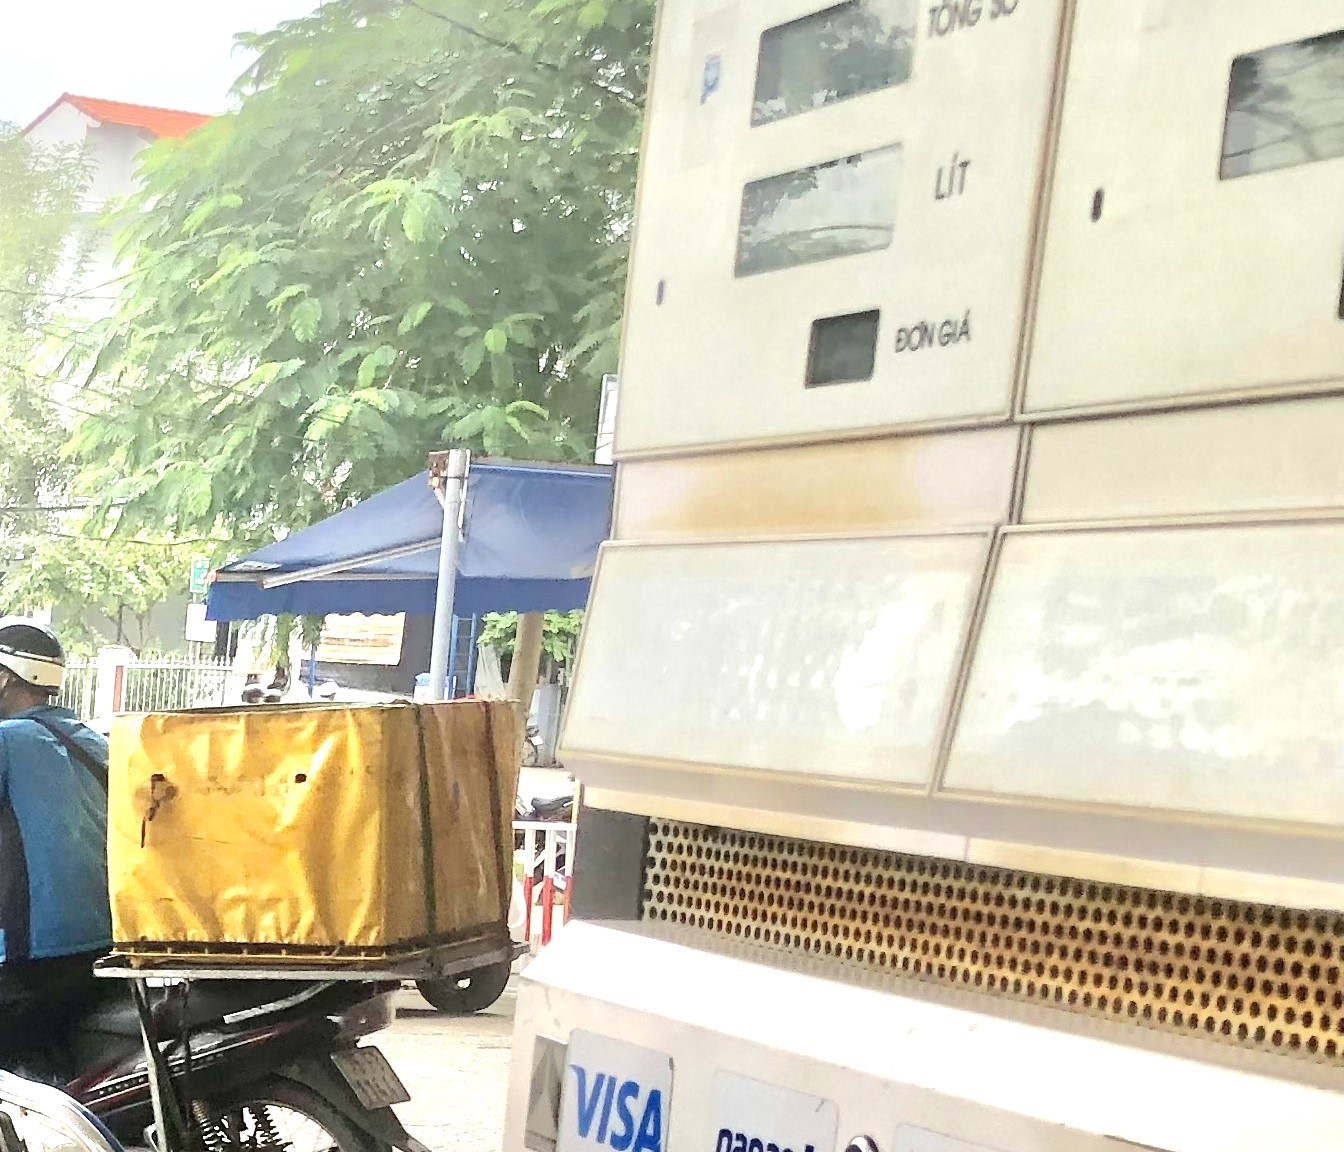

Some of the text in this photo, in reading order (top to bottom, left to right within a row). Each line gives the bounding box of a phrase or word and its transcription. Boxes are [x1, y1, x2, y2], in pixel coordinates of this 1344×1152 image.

[934, 152, 971, 201] LÍT
[895, 308, 971, 353] ĐƠN GIÁ
